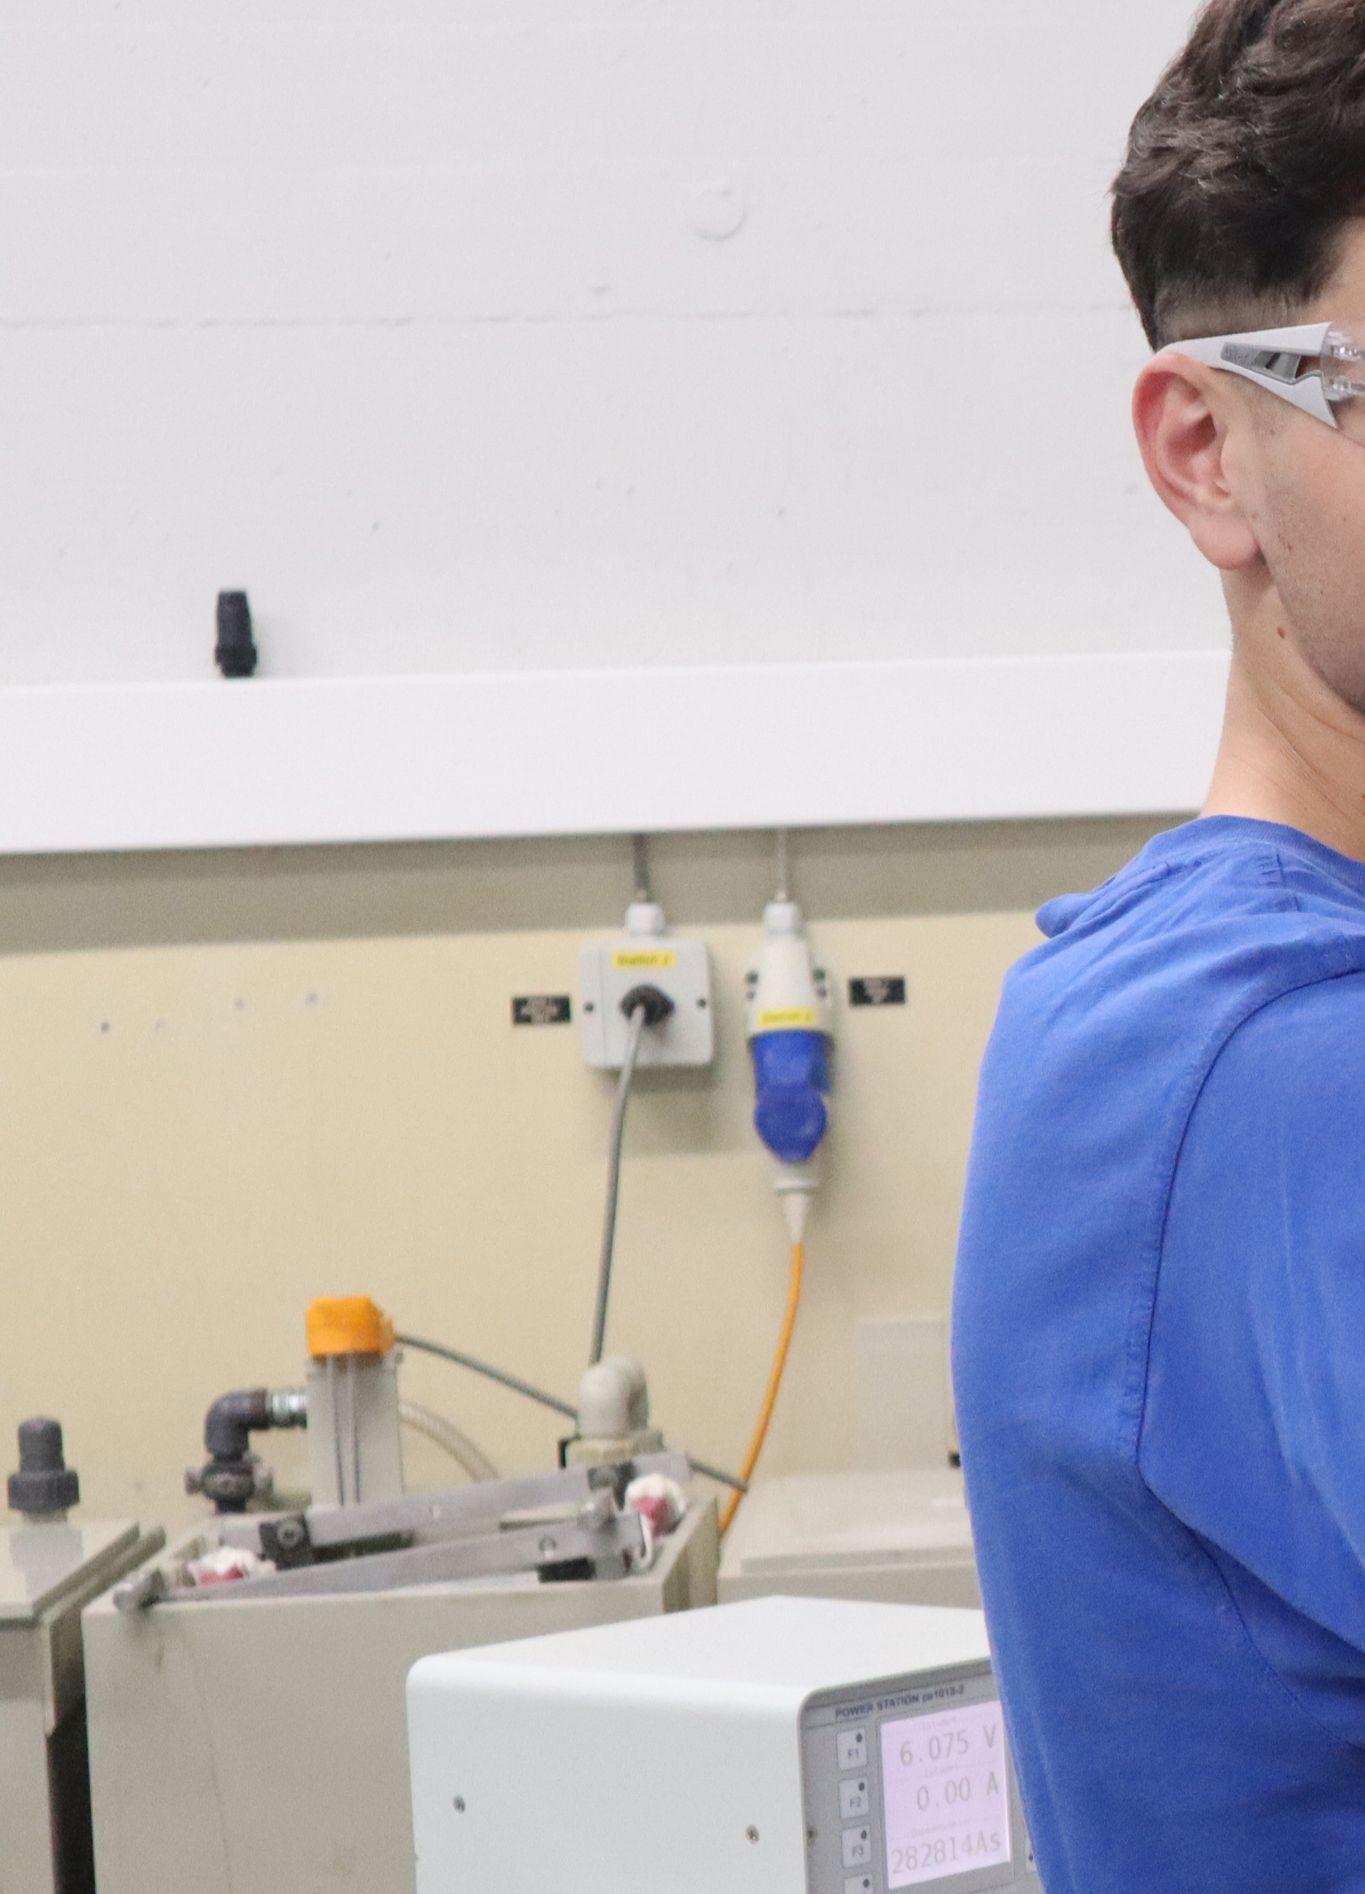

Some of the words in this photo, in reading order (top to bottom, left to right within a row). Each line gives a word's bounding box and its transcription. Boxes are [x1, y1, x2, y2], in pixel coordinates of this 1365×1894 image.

[834, 1702, 874, 1720] POWER
[876, 1693, 920, 1711] STATION
[900, 1729, 969, 1767] 6.075
[982, 1724, 997, 1749] V
[916, 1775, 971, 1812] 0.00
[986, 1771, 999, 1796] A
